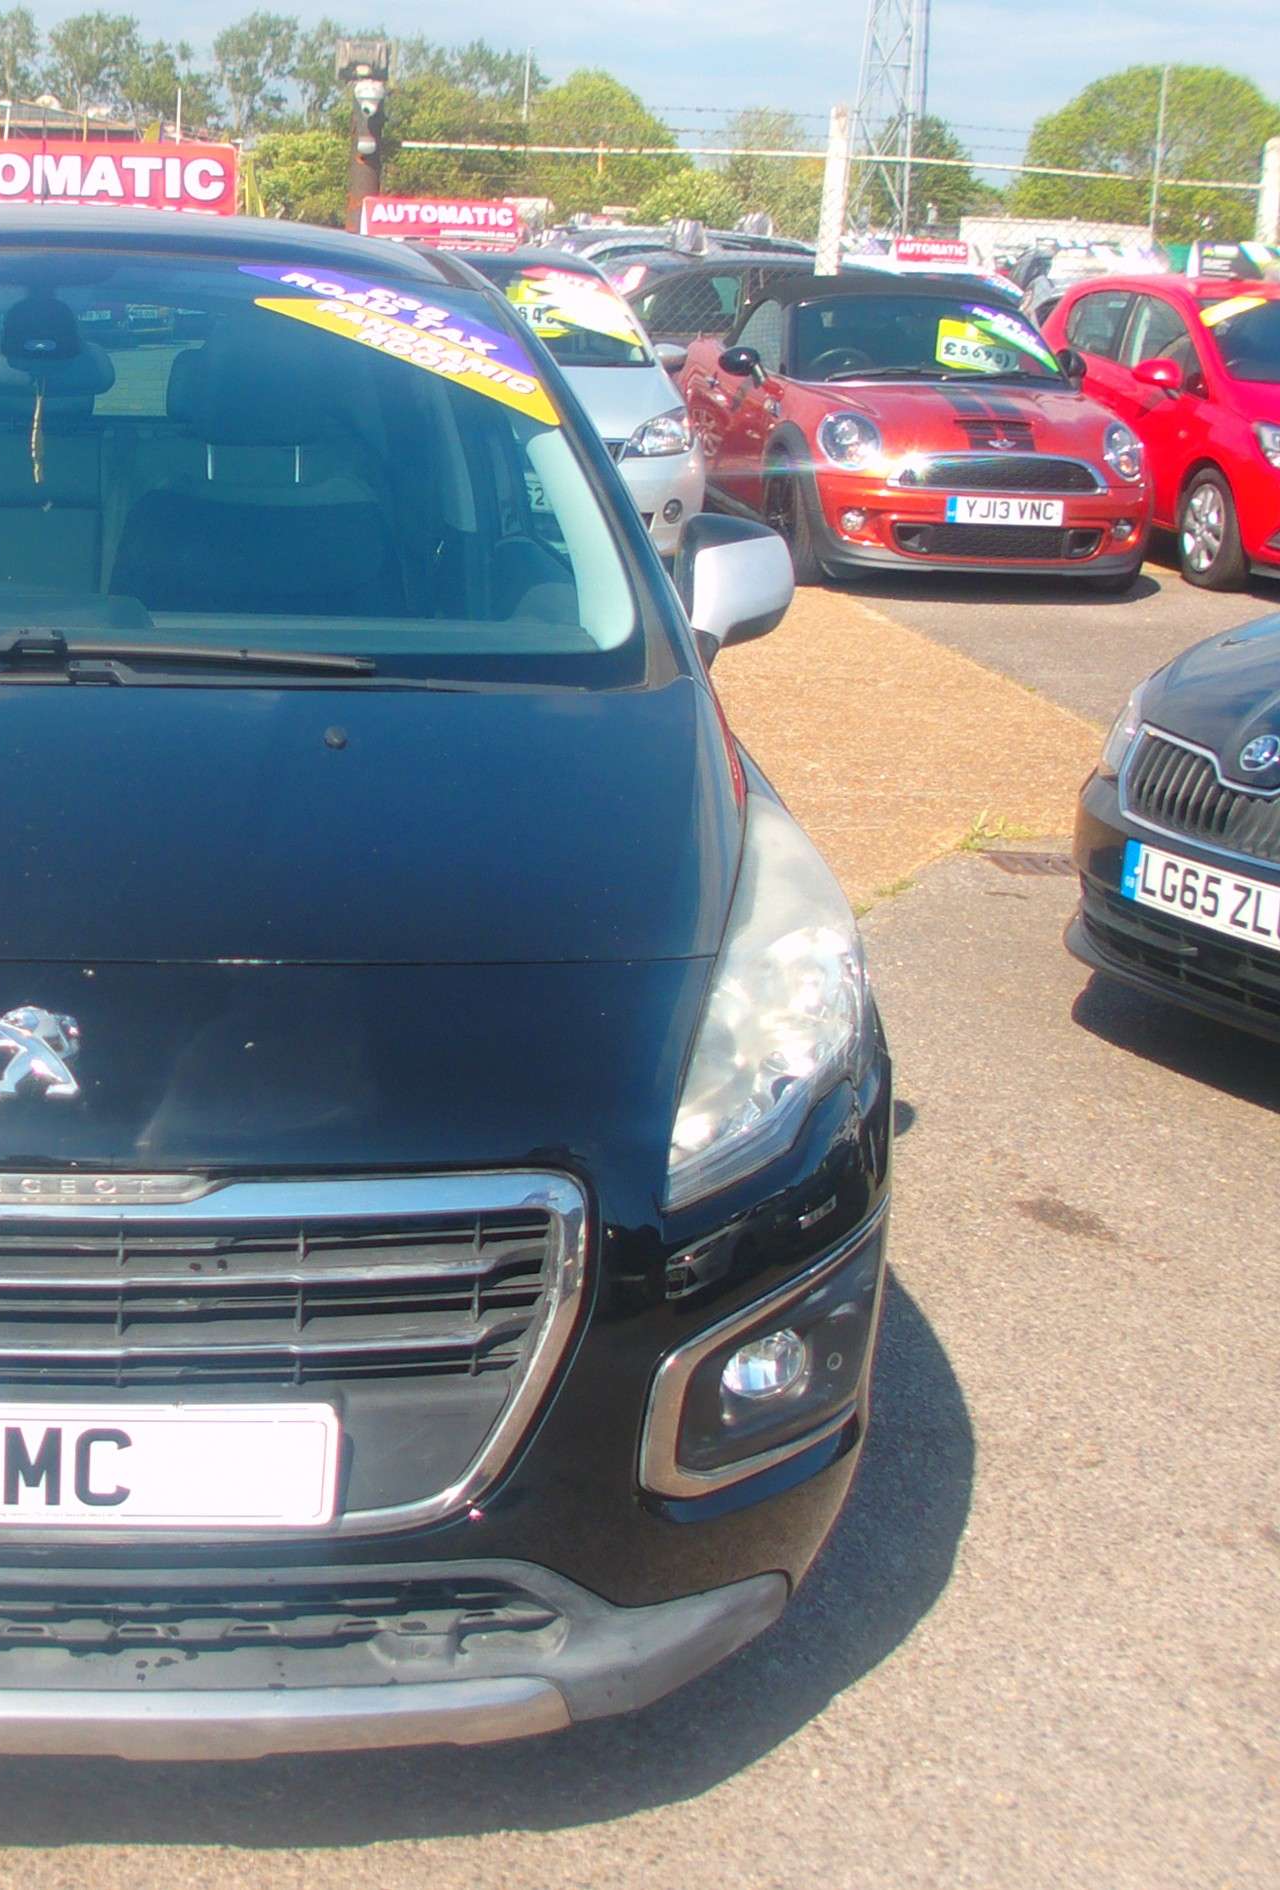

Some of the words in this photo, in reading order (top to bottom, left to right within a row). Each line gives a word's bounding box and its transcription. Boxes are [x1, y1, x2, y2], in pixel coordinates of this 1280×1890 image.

[372, 204, 514, 227] AUTOMATIC
[897, 243, 967, 256] AUTOMATIC
[280, 272, 400, 316] ROAD
[412, 313, 499, 355] TAX
[316, 301, 536, 394] PANORAMIC
[966, 499, 1011, 520] YJ13
[1018, 501, 1055, 521] VNC
[1140, 852, 1222, 919] LG65
[1228, 882, 1280, 940] ZL
